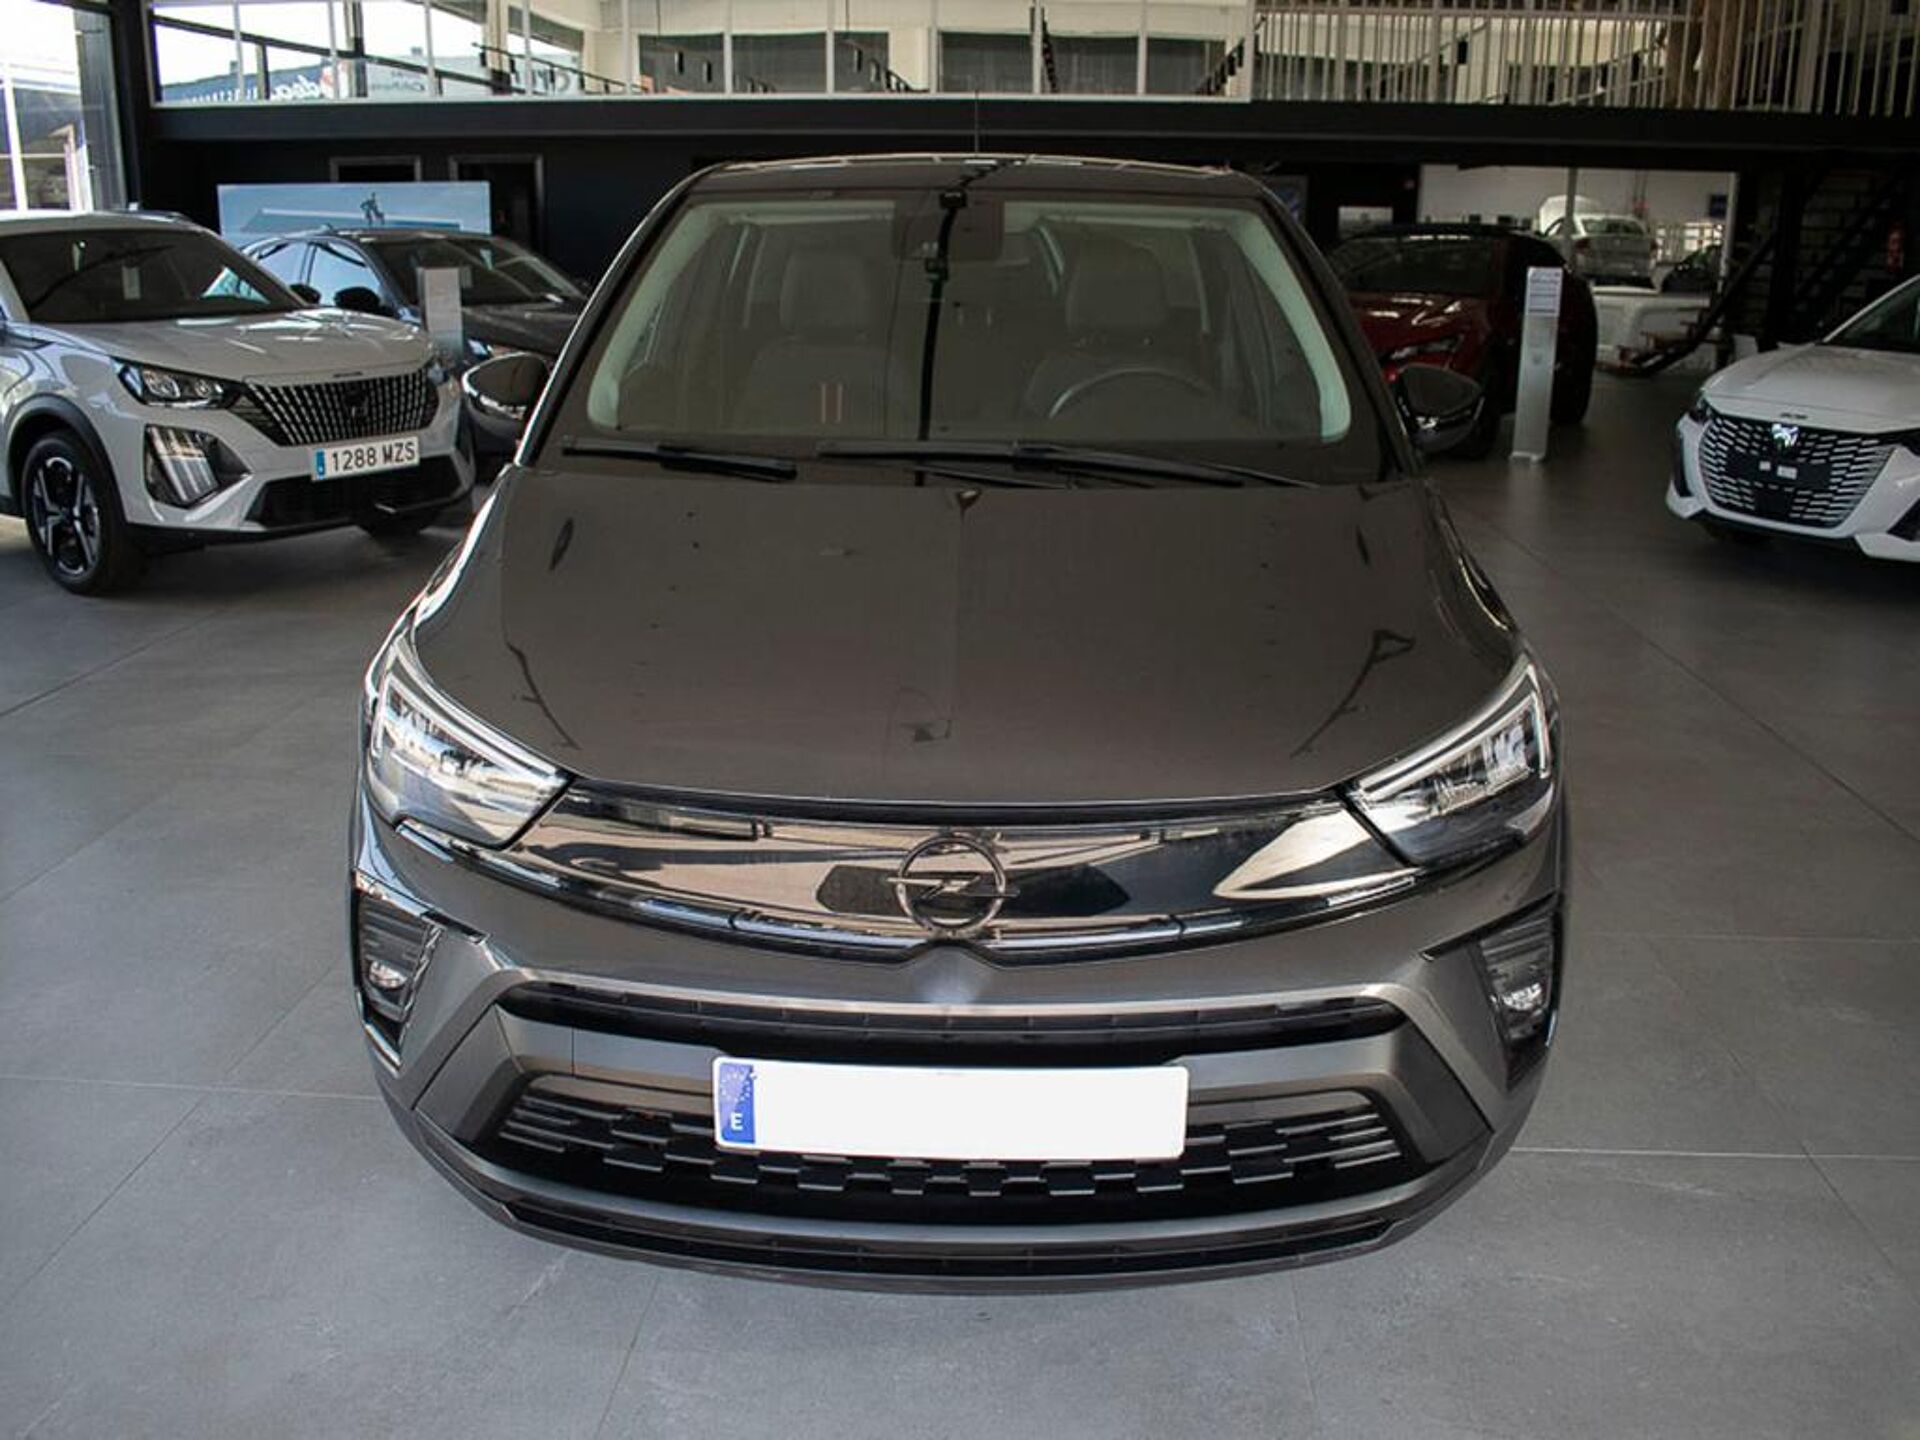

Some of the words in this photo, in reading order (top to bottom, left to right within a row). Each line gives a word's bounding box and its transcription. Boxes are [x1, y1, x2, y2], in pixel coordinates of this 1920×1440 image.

[332, 447, 376, 471] 1288
[382, 442, 415, 464] MZS
[730, 1112, 744, 1132] E
